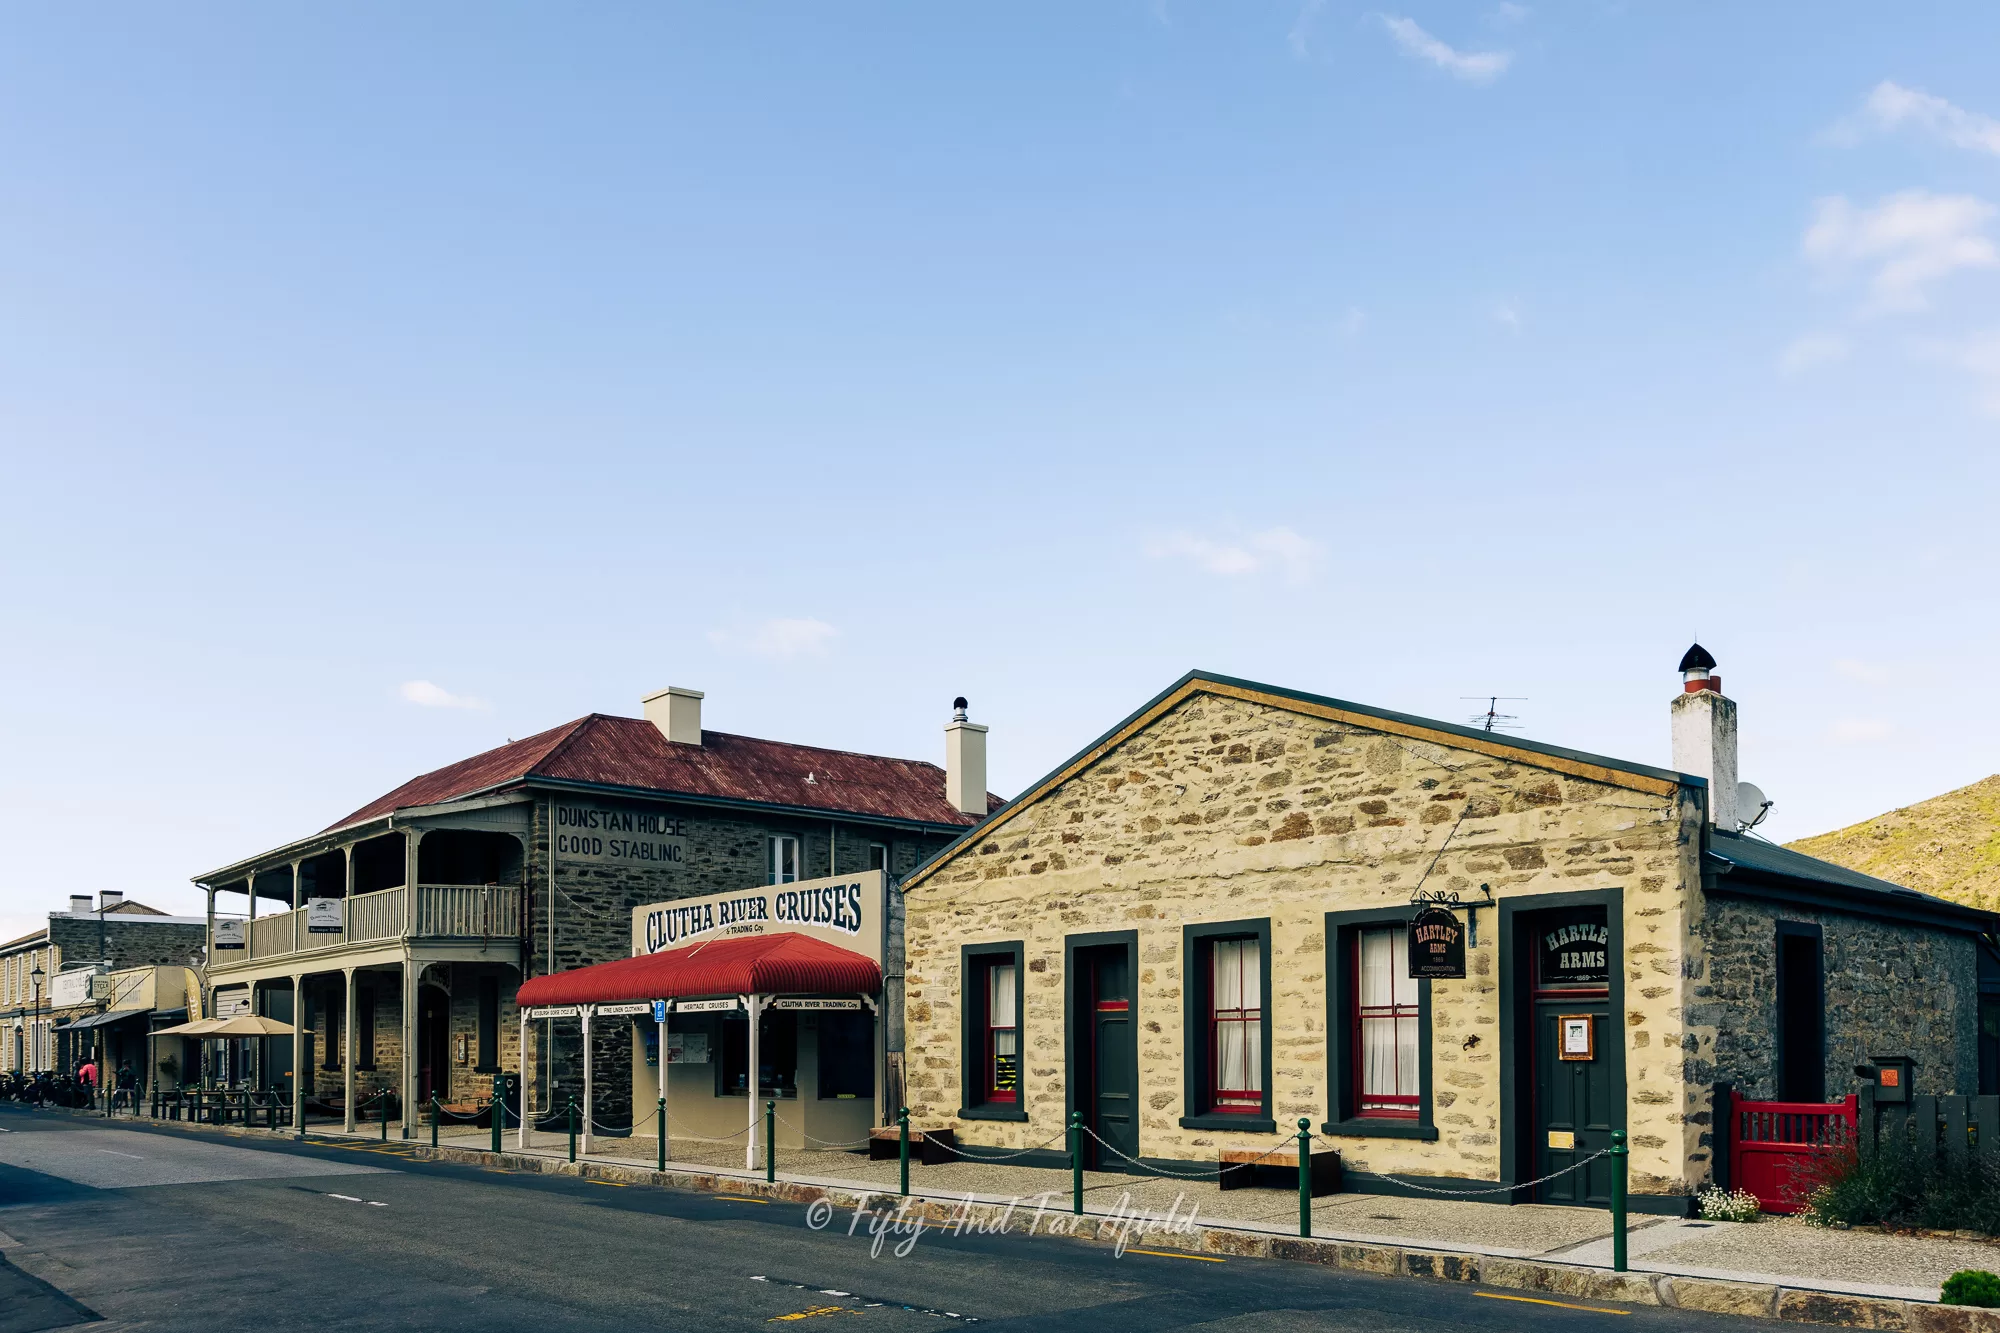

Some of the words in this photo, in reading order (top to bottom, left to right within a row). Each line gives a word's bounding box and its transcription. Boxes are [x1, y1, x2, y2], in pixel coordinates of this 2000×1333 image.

[558, 806, 633, 832] DUNSTAN
[637, 814, 687, 836] HOUSE
[646, 904, 715, 954] CLUTHA
[717, 896, 769, 926] RIVER
[775, 883, 862, 936] CRUISES
[731, 924, 753, 934] TRADING
[1416, 924, 1458, 944] HARTLEY
[1429, 943, 1446, 953] ARMS
[1560, 951, 1605, 969] ARMS
[684, 1002, 705, 1010] HERITAGE
[709, 1001, 729, 1009] CRUISES
